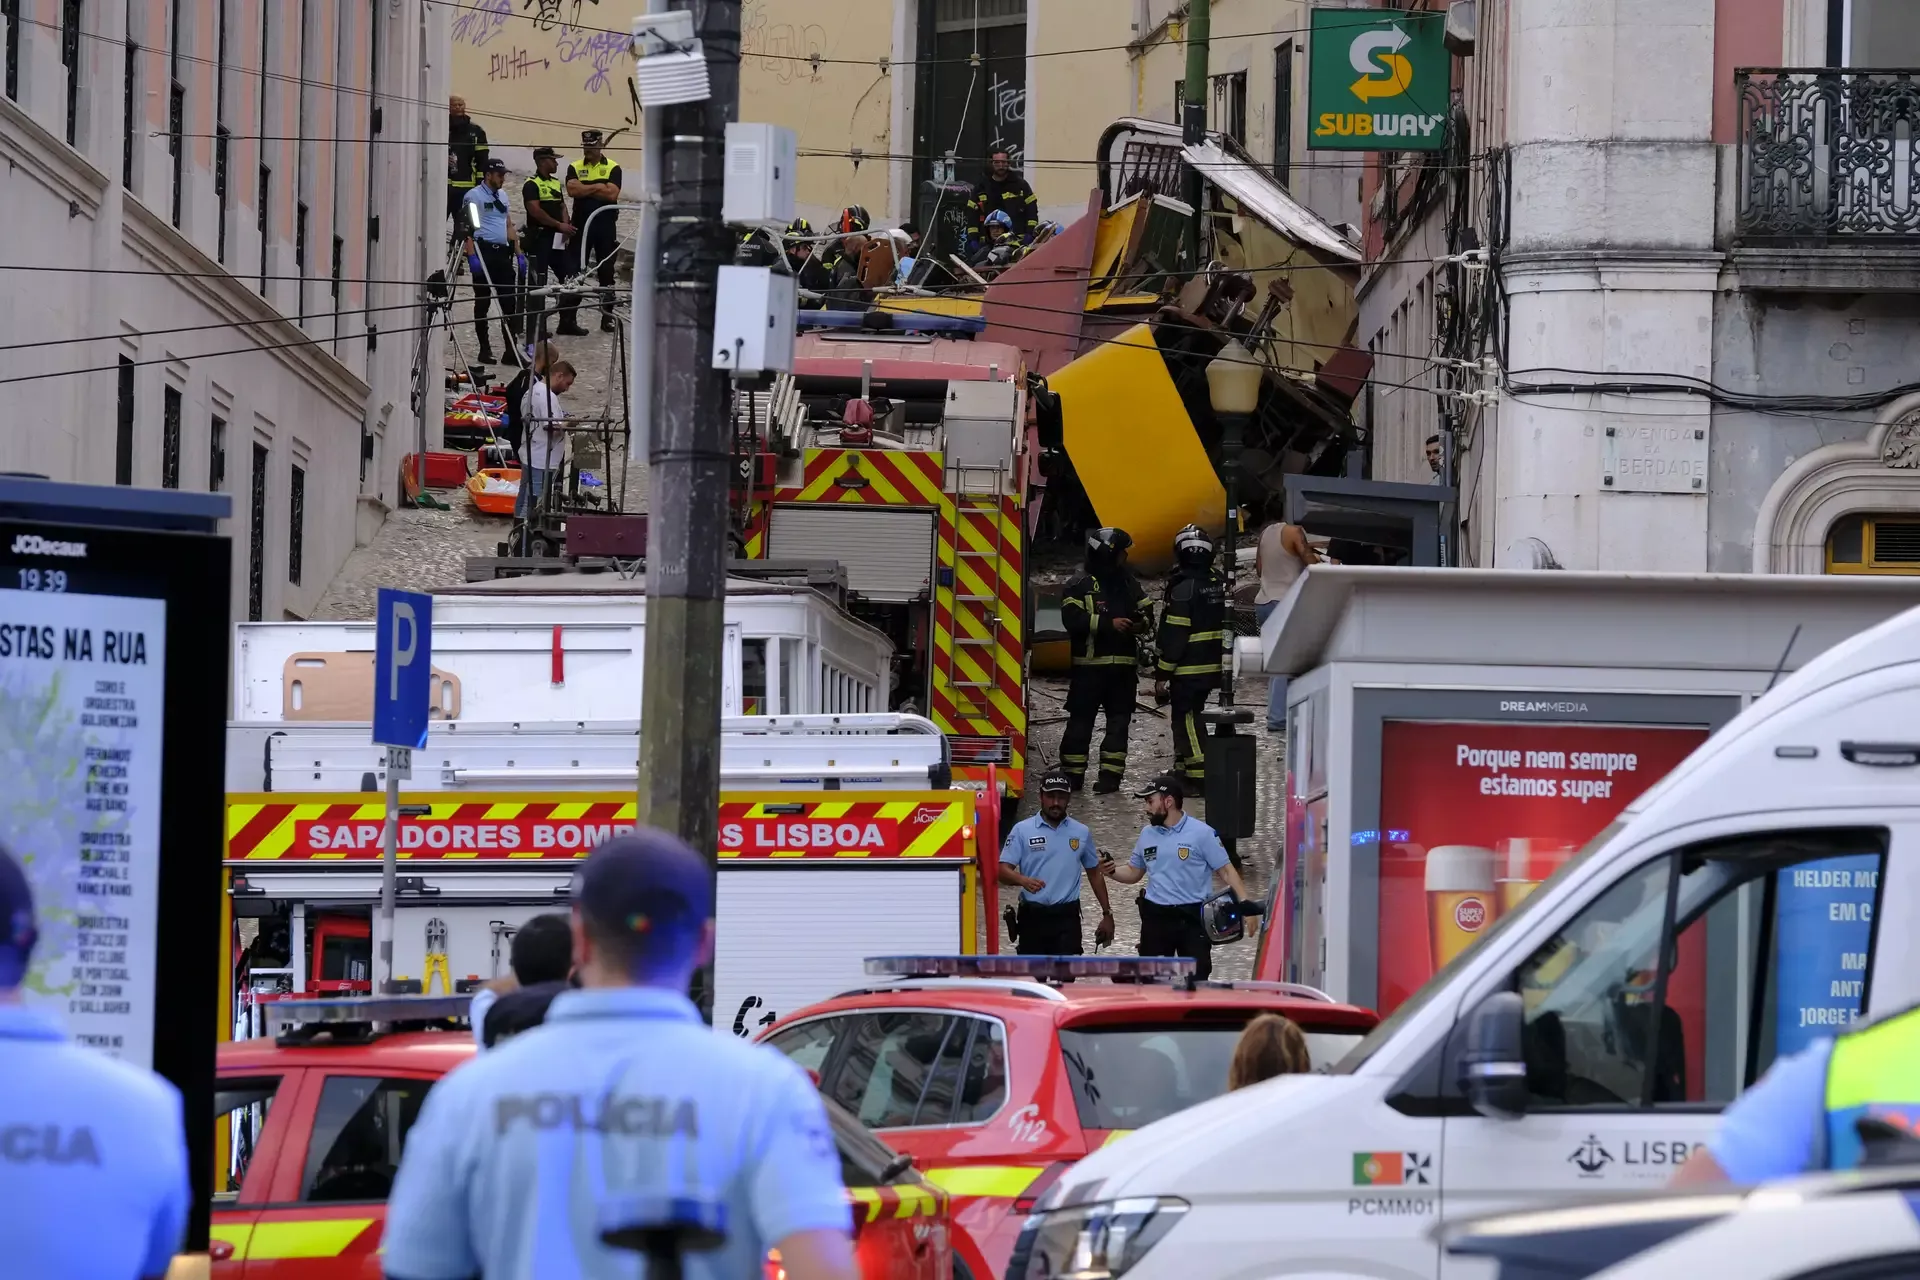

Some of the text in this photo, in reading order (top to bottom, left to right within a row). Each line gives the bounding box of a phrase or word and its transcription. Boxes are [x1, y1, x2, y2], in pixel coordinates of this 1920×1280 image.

[1314, 113, 1445, 137] SUBWAY
[1615, 427, 1694, 441] AVENIDA
[1602, 458, 1704, 476] LIBERDADE
[12, 535, 87, 557] JCDecaux
[64, 628, 93, 661] NA
[103, 630, 147, 665] RUA
[390, 601, 417, 700] P
[1457, 744, 1637, 776] Porque nem sempre
[1480, 773, 1613, 804] estamos super
[308, 824, 521, 848] SAPADORES
[756, 824, 885, 847] LISBOA
[1794, 870, 1851, 888] HELDER
[1829, 903, 1857, 921] EM
[1842, 953, 1867, 970] MA
[1831, 980, 1864, 997] ANT
[1799, 1008, 1847, 1028] JORGE
[1010, 1119, 1046, 1142] 112
[1625, 1142, 1706, 1164] LISB
[1349, 1198, 1434, 1216] PCMM01
